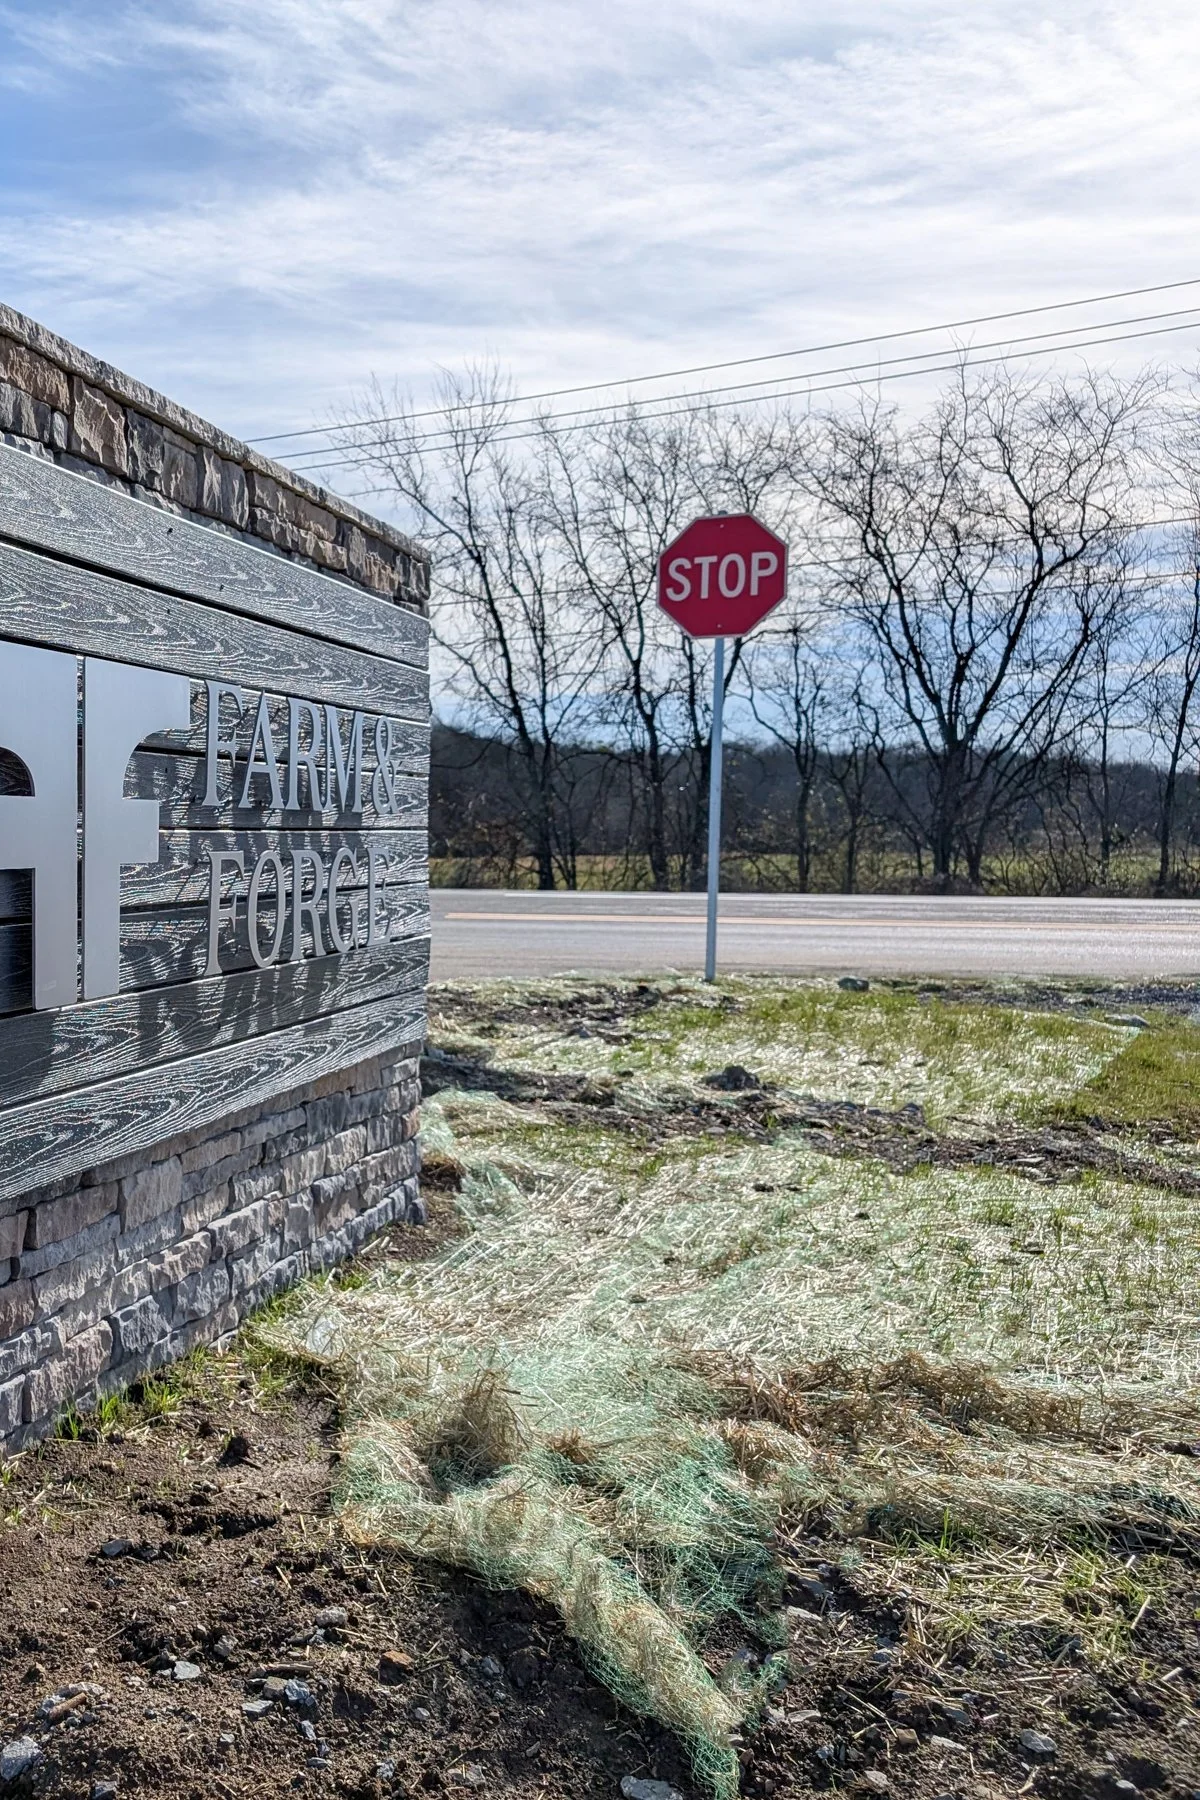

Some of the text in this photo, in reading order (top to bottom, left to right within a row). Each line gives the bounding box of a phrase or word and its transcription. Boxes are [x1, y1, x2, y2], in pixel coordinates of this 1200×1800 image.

[666, 551, 778, 602] STOP
[202, 679, 364, 813] FARM
[203, 847, 391, 977] FORGE
